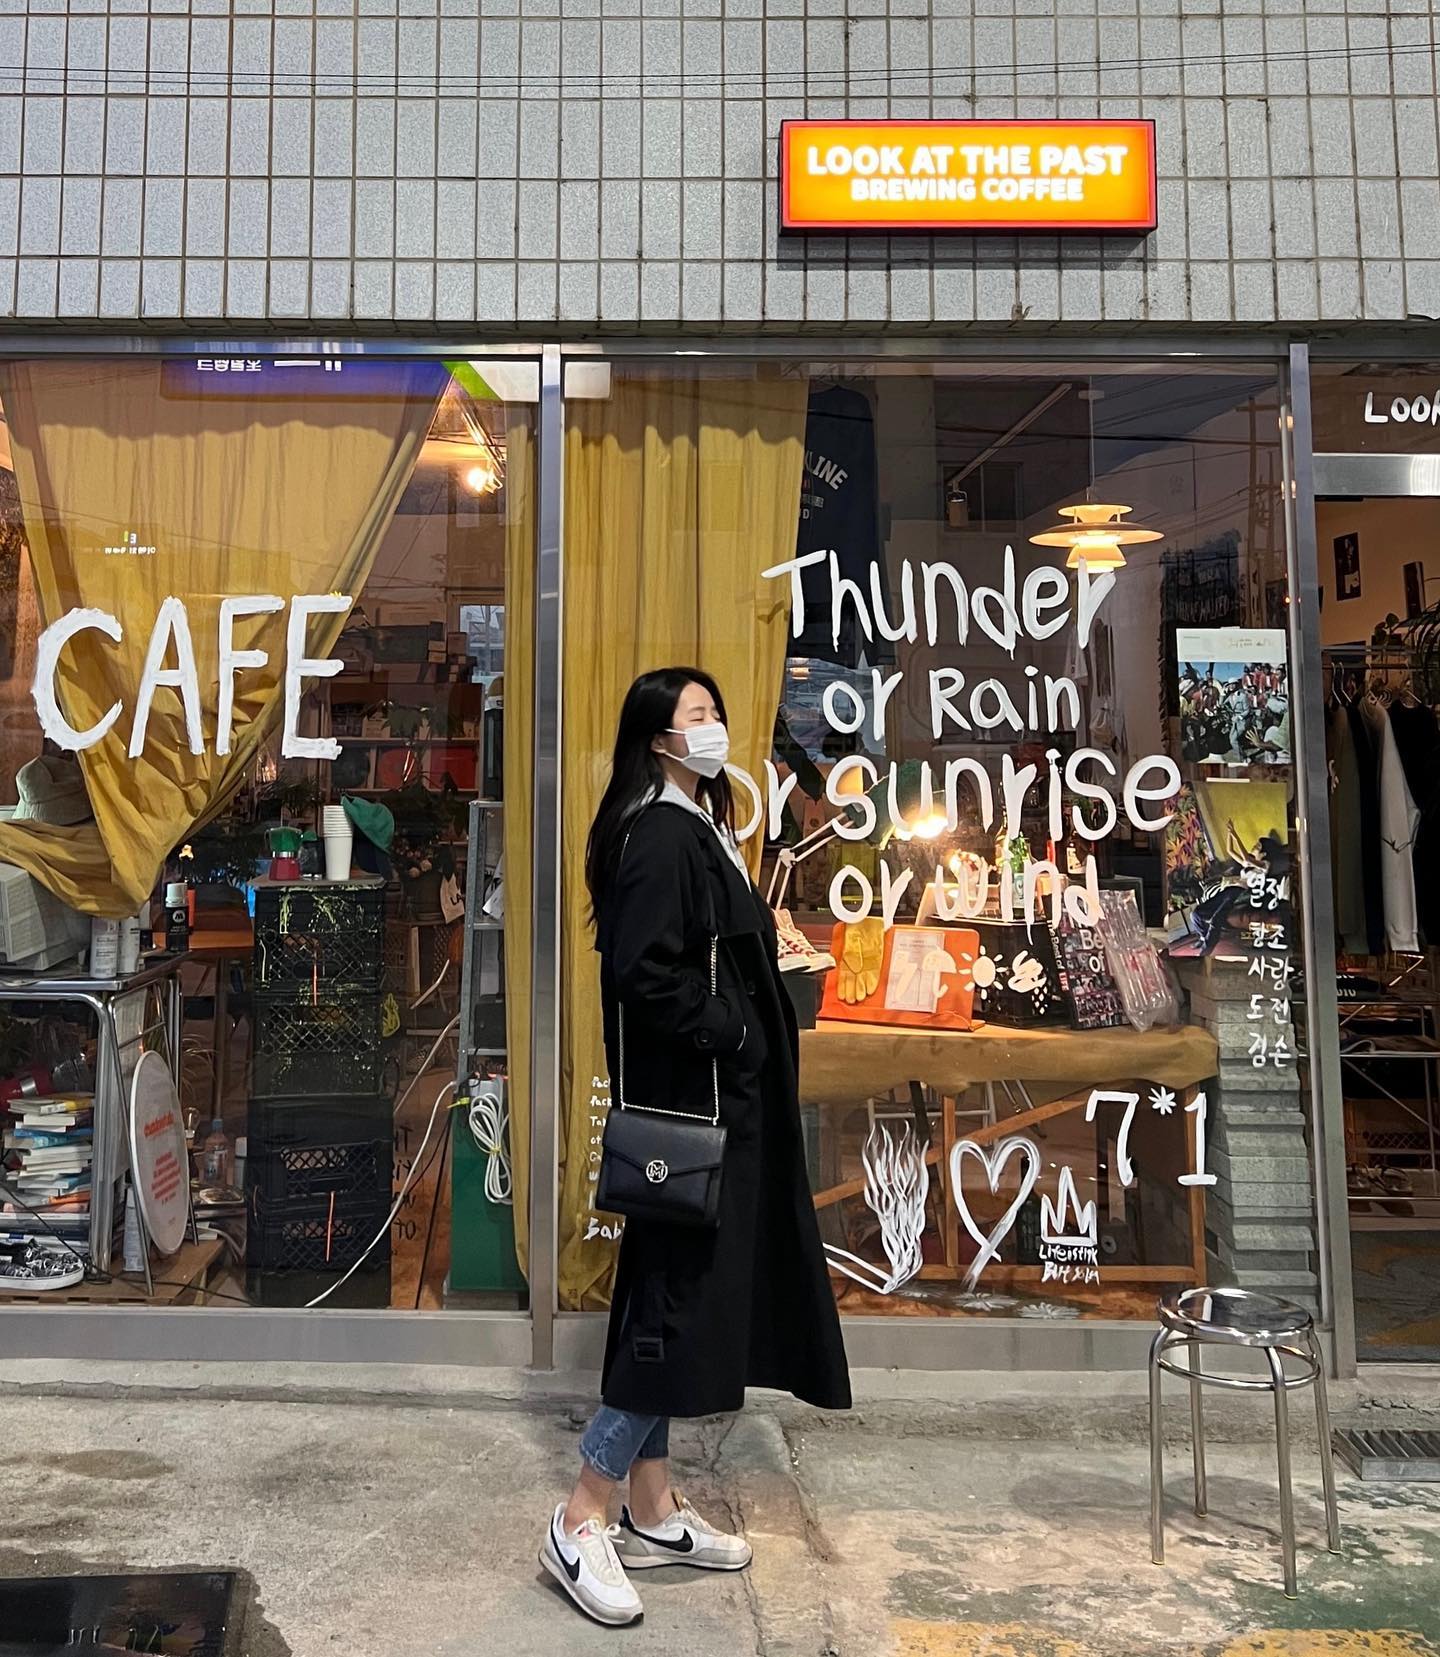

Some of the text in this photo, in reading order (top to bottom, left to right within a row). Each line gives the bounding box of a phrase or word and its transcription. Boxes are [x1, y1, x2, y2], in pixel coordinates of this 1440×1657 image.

[807, 145, 1128, 176] LOOK AT THE PAST
[850, 178, 1084, 201] BREWING COFFEE
[761, 545, 1116, 660] Thunder
[30, 595, 353, 760] CAFE
[822, 665, 1080, 741] or Rain
[723, 747, 1182, 842] or sunrise
[829, 854, 1104, 945] or wind
[1247, 871, 1288, 910] 열정
[1079, 929, 1104, 950] Be
[1248, 921, 1288, 949] 창조
[1058, 971, 1069, 992] LIFE
[1248, 955, 1294, 991] 사랑
[1246, 994, 1289, 1025] 도전
[583, 1217, 625, 1241] Bab
